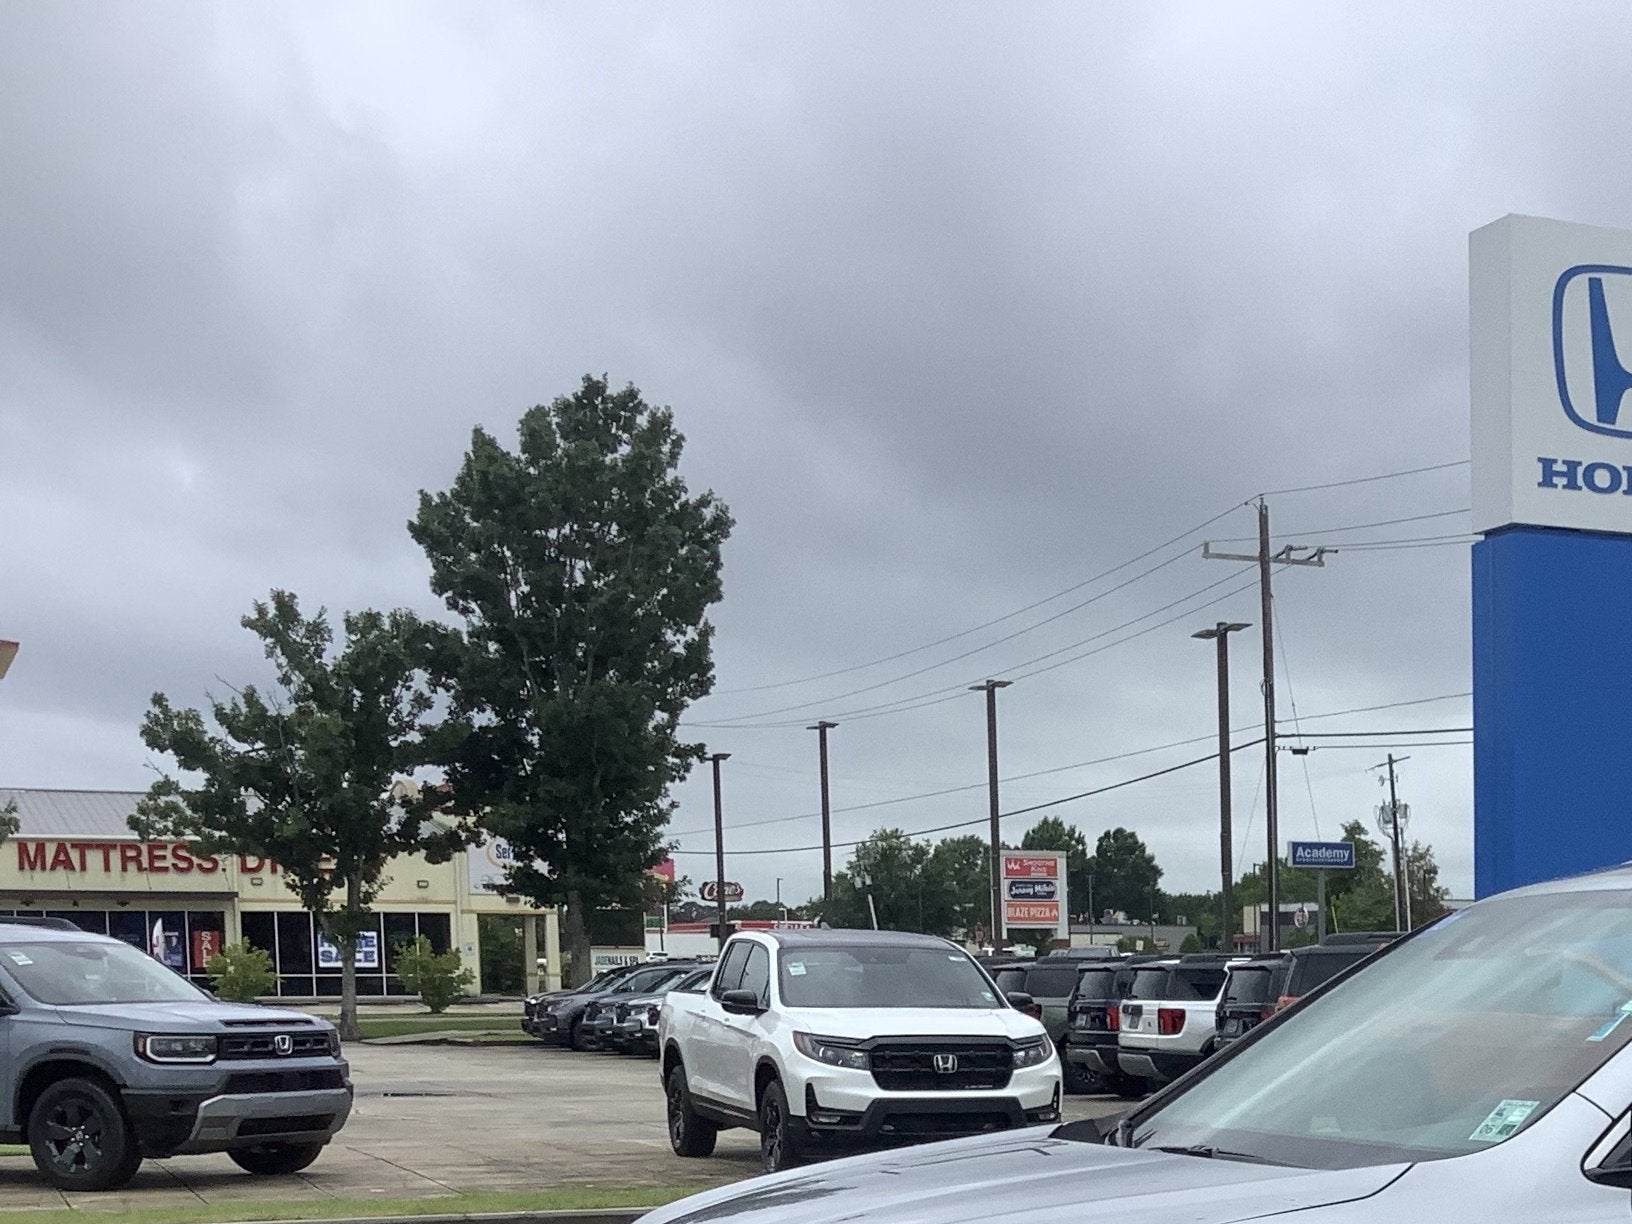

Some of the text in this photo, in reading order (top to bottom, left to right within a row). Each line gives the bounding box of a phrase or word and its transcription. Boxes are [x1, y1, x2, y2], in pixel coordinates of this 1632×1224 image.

[17, 842, 219, 873] MATTRESS
[1295, 846, 1350, 861] Academy
[1007, 907, 1051, 918] BLAZE PIZZA
